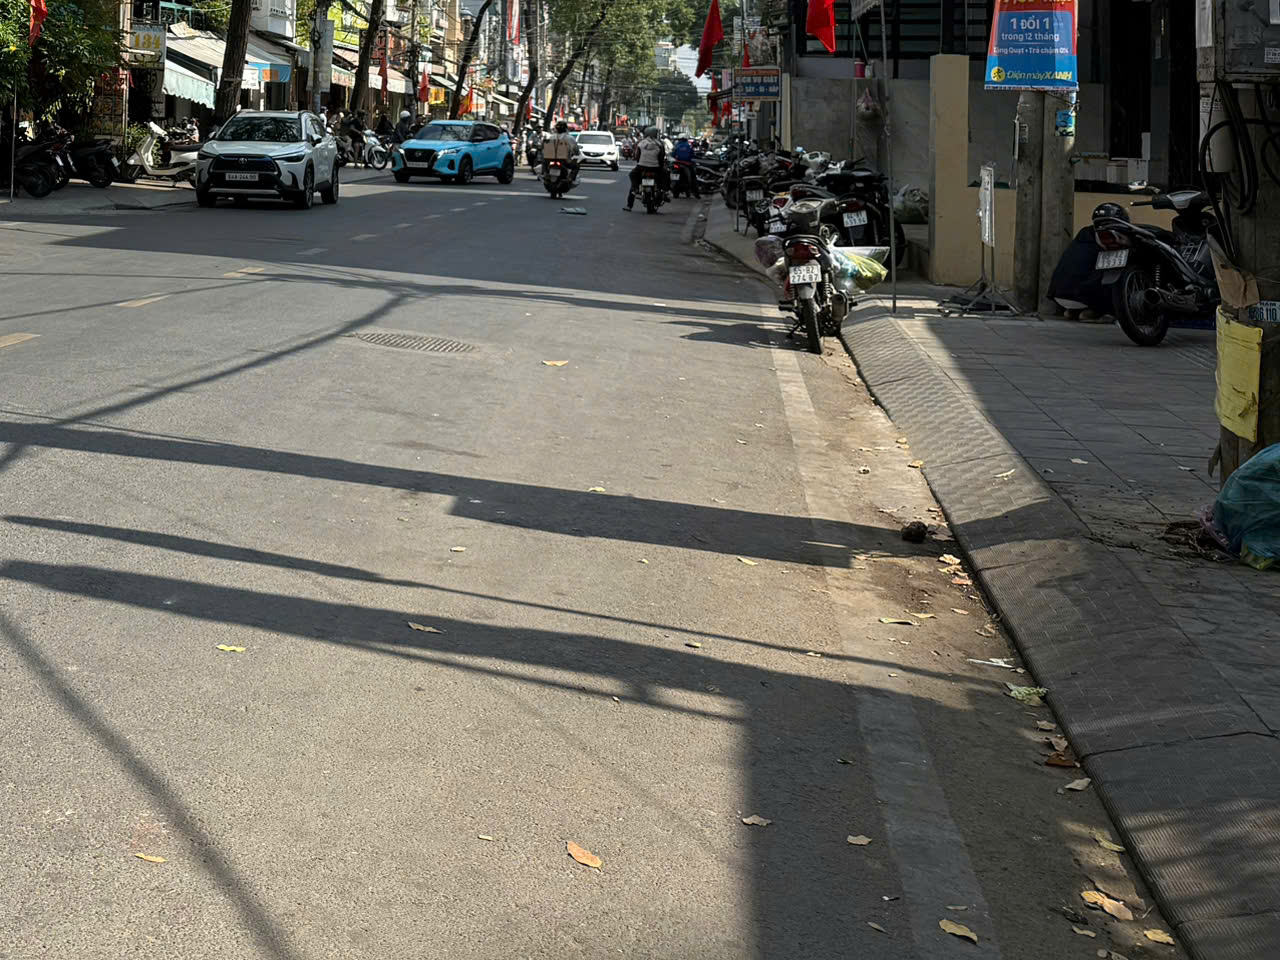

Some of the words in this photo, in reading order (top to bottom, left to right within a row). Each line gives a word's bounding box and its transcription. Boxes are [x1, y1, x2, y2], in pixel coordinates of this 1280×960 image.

[1010, 17, 1017, 30] 1
[1020, 15, 1040, 30] ĐỔI
[1043, 17, 1050, 30] 1
[1001, 33, 1024, 42] trong
[1025, 33, 1033, 41] 12
[1035, 32, 1060, 42] tháng
